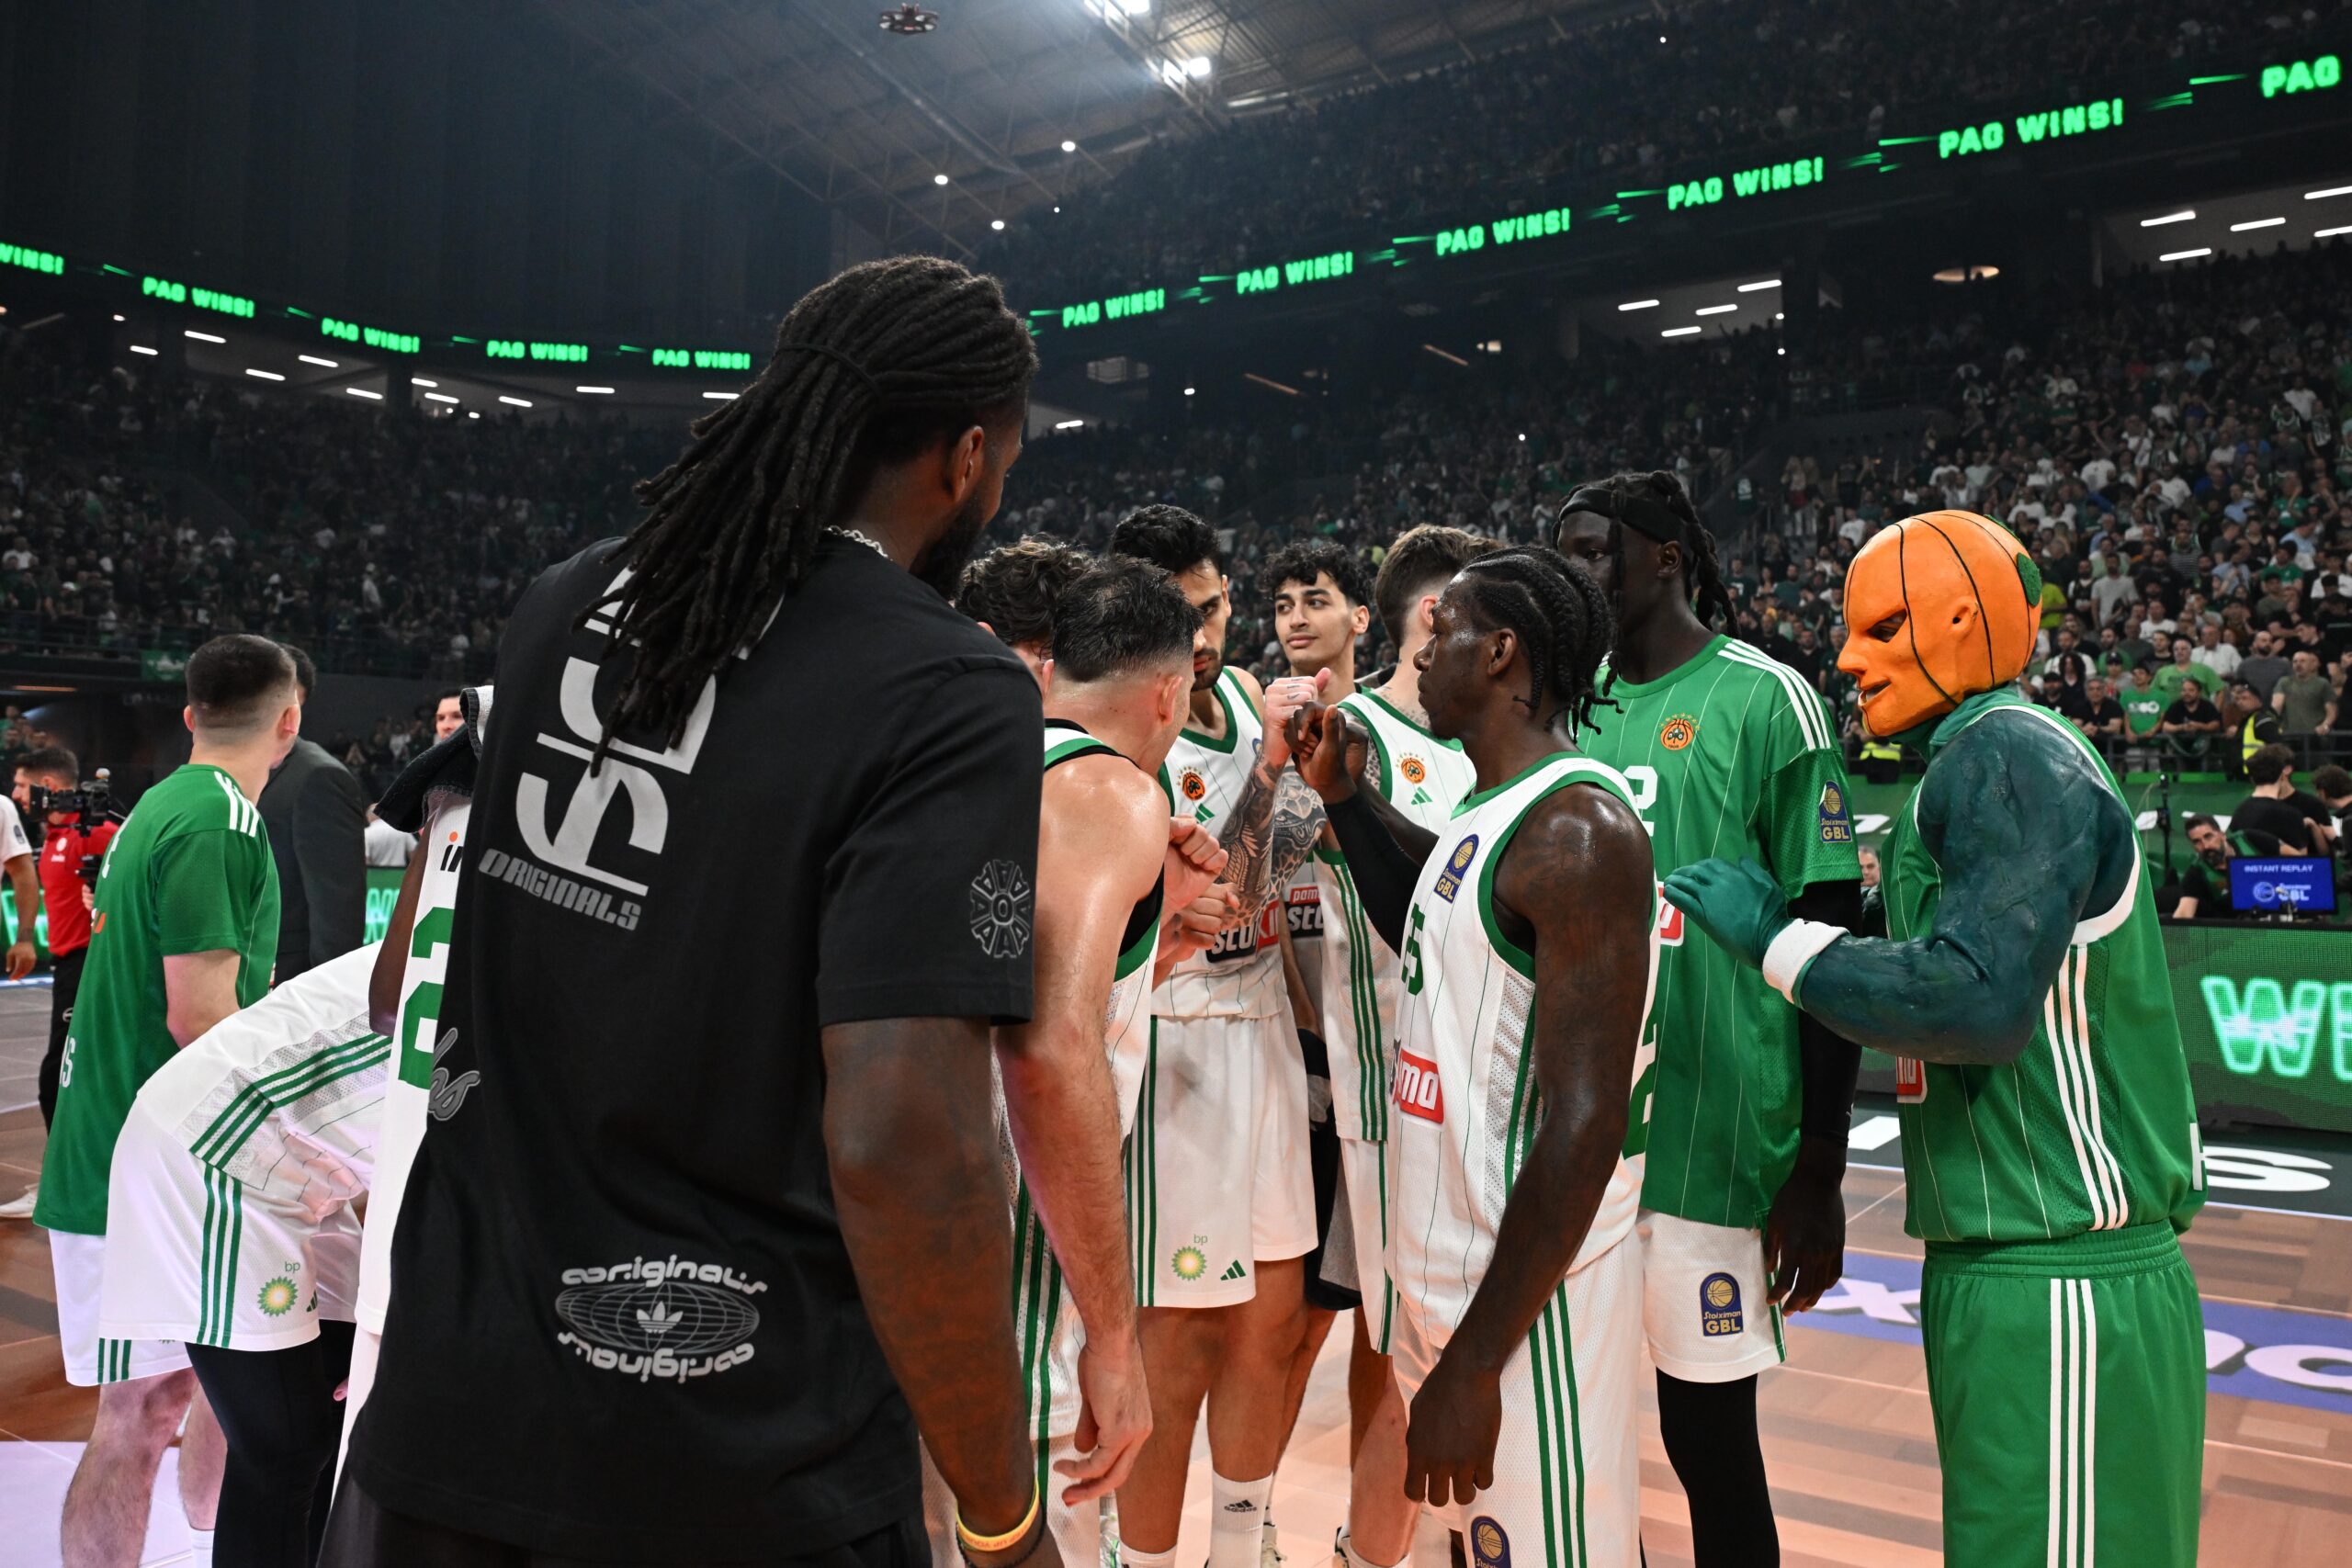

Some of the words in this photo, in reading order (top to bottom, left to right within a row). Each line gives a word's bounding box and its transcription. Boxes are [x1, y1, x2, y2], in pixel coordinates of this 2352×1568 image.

[2015, 97, 2123, 144] WINS!
[1732, 156, 1824, 197] WINS!
[1491, 207, 1571, 245] WINS!
[1283, 250, 1354, 286] WINS!
[190, 287, 255, 319] WINS!
[1103, 287, 1166, 321] WINS!
[363, 326, 421, 354] WINS!
[529, 342, 589, 363] WINS!
[694, 350, 752, 370] WINS!
[1822, 826, 1849, 840] GBL
[2245, 864, 2279, 873] INSTANT
[2281, 864, 2313, 873] REPLAY
[479, 848, 641, 931] ORIGINALS
[1437, 877, 1454, 900] GBL
[1193, 1235, 1208, 1244] bp
[285, 1261, 301, 1273] bp
[1703, 1311, 1742, 1320] Stoiximan
[1705, 1320, 1741, 1335] GBL
